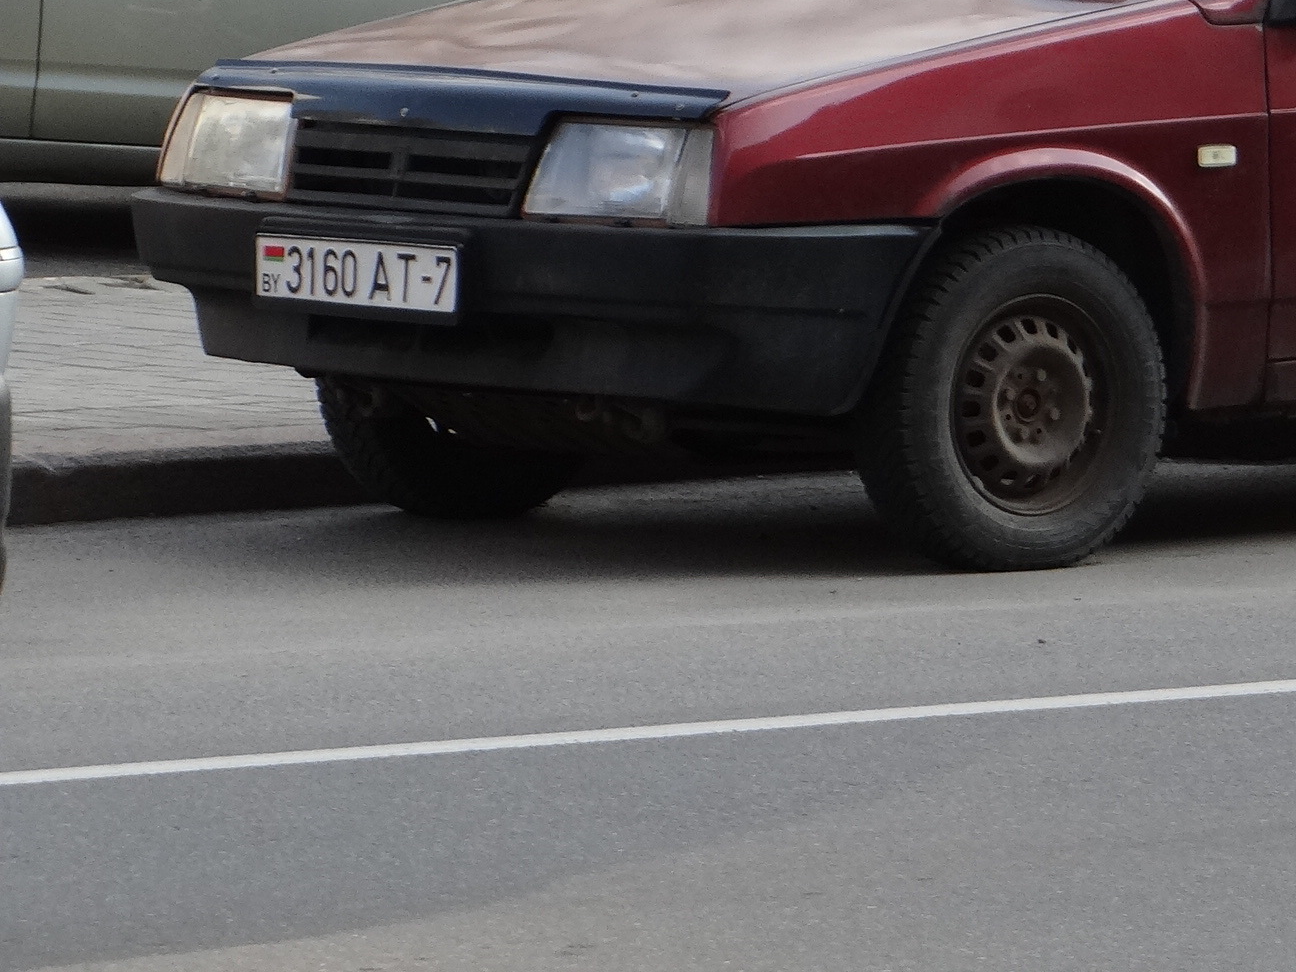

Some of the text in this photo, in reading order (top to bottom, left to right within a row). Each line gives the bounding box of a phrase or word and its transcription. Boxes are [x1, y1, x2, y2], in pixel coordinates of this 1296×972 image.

[262, 272, 281, 293] BY
[286, 245, 451, 305] 3160 AT-7
